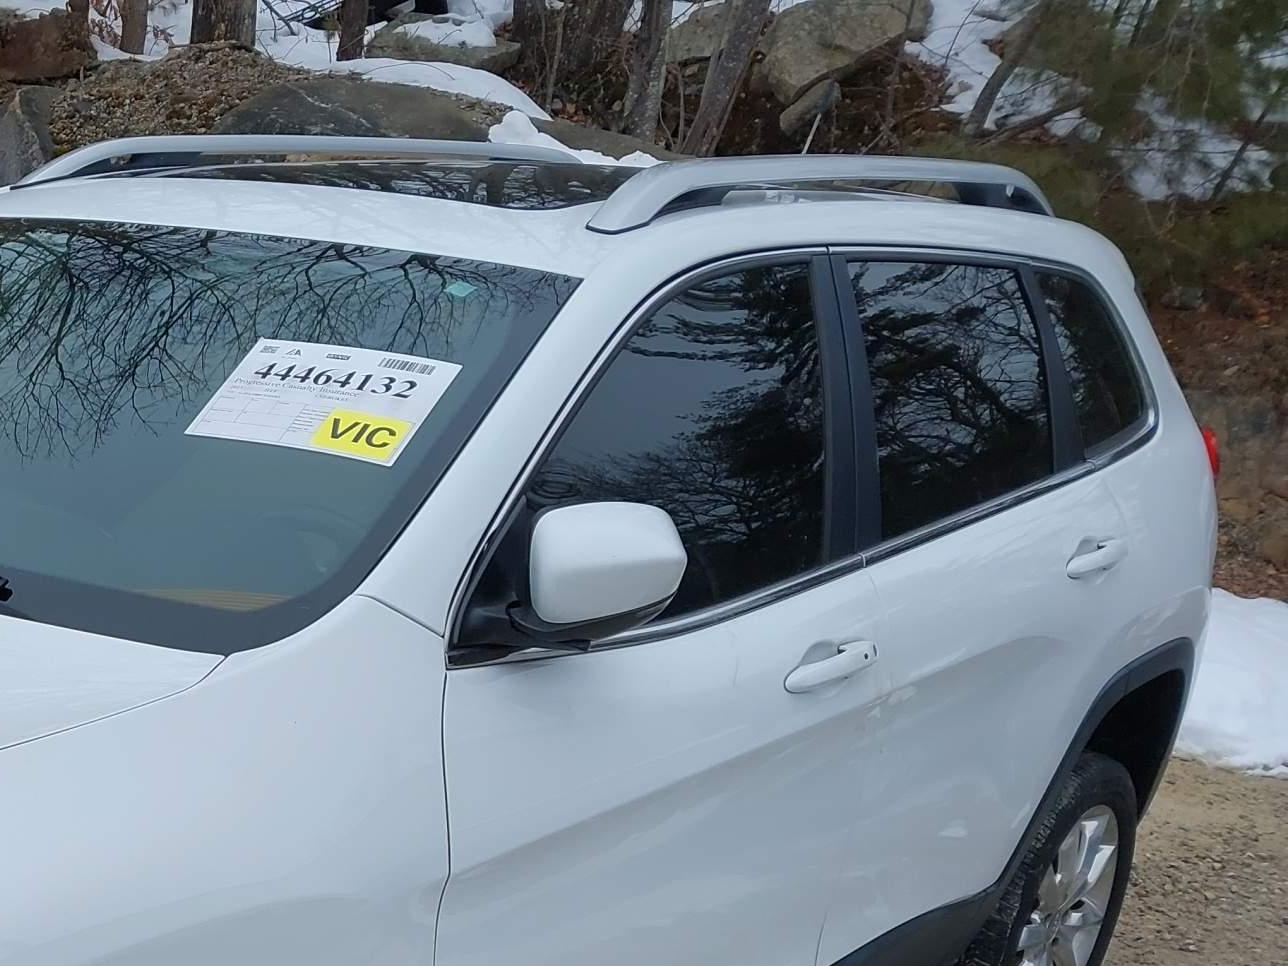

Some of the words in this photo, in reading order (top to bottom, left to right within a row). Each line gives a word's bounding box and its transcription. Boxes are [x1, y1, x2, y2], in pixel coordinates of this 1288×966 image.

[234, 377, 281, 388] Progressive
[282, 381, 315, 393] Casualty
[320, 386, 360, 397] Insurance
[254, 361, 418, 398] 44464132
[330, 417, 397, 449] VIC
